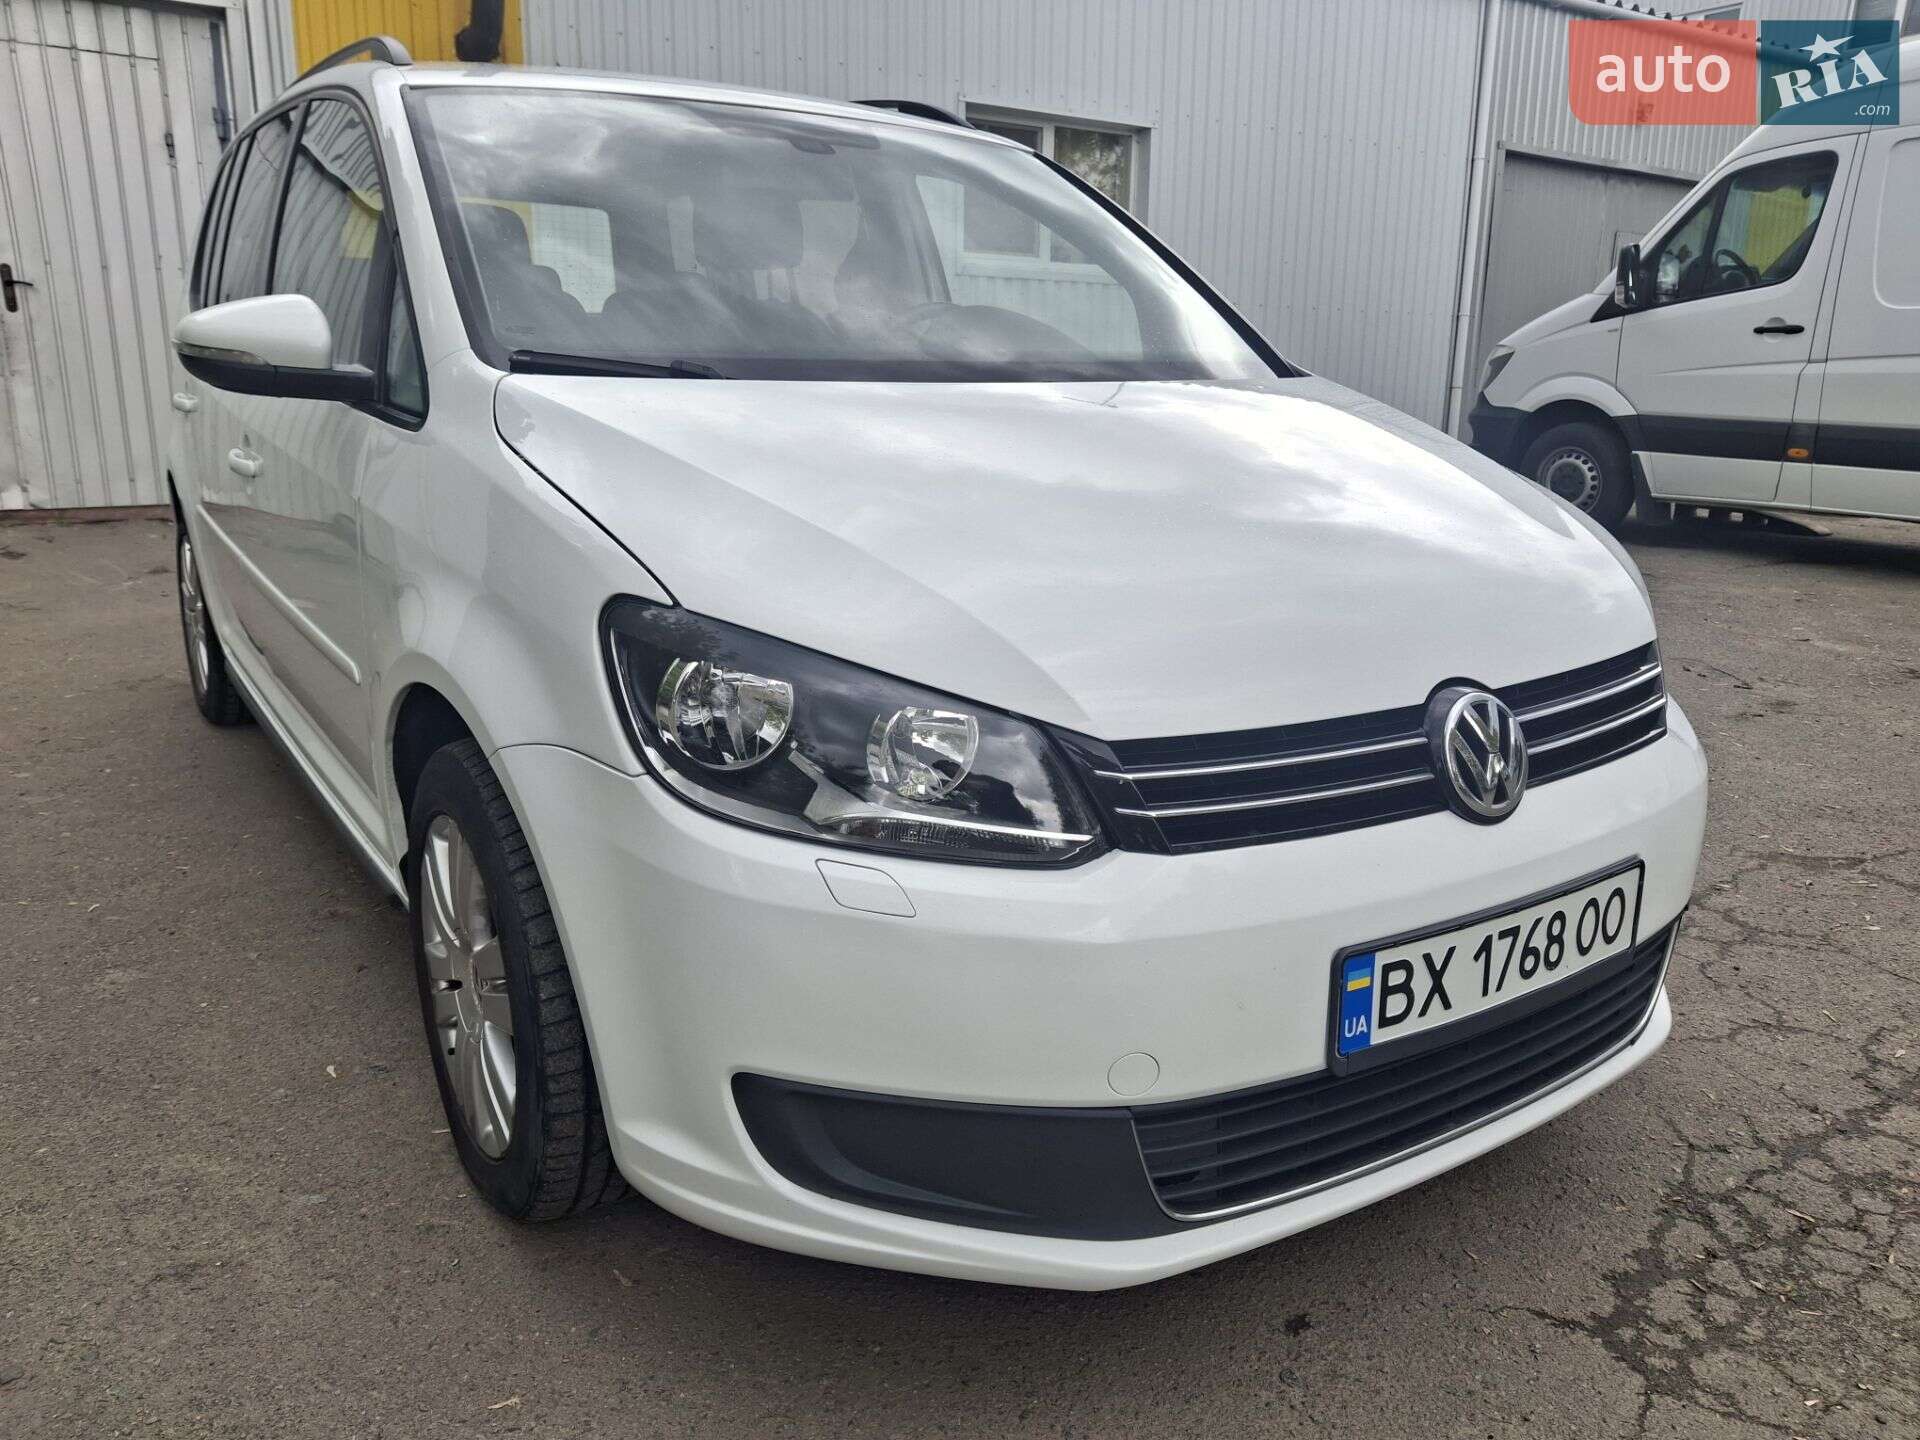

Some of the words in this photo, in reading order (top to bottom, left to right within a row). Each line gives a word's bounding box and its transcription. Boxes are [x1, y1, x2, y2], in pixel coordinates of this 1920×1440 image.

[1377, 945, 1456, 1030] BX
[1472, 910, 1567, 998] 1768
[1344, 1014, 1369, 1038] UA
